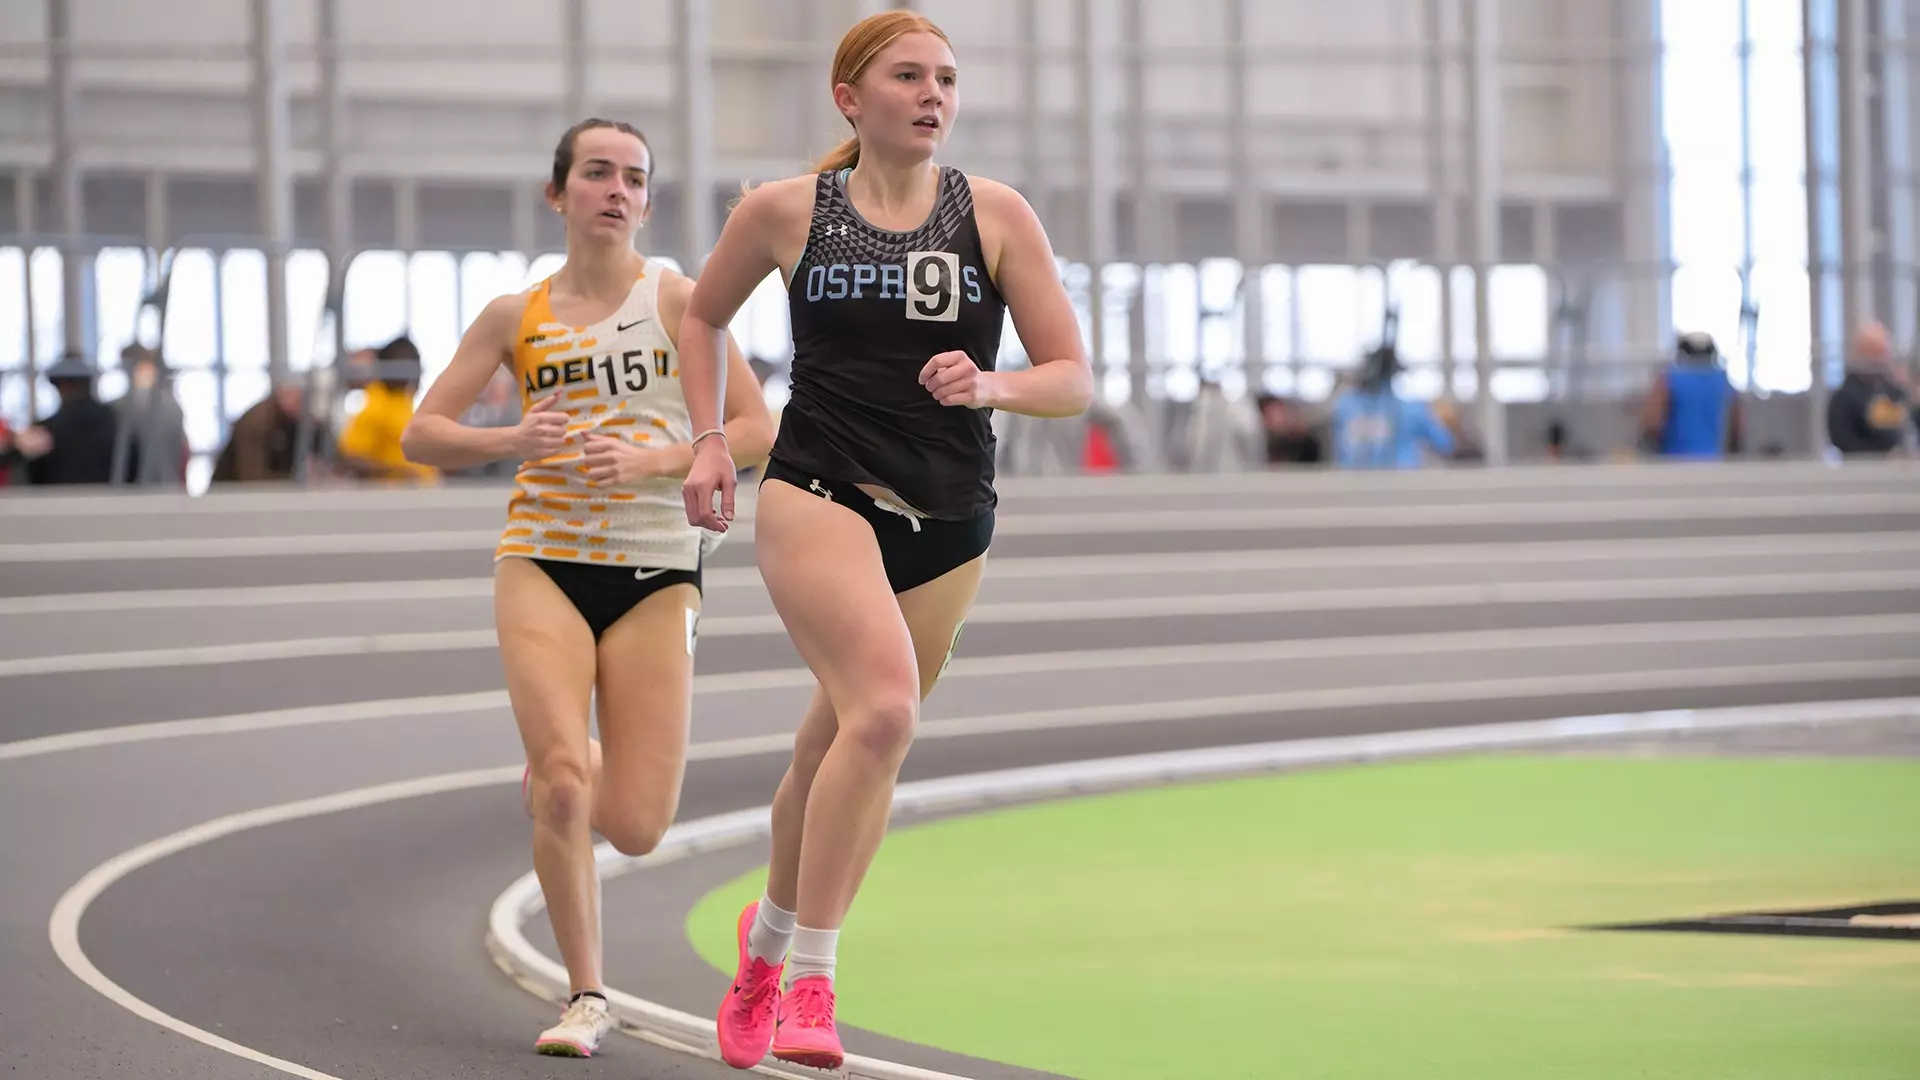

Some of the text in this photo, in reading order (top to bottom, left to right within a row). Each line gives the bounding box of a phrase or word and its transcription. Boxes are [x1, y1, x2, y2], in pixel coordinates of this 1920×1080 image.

[806, 264, 982, 303] OSPRS
[913, 255, 952, 317] 9
[597, 350, 649, 396] 15
